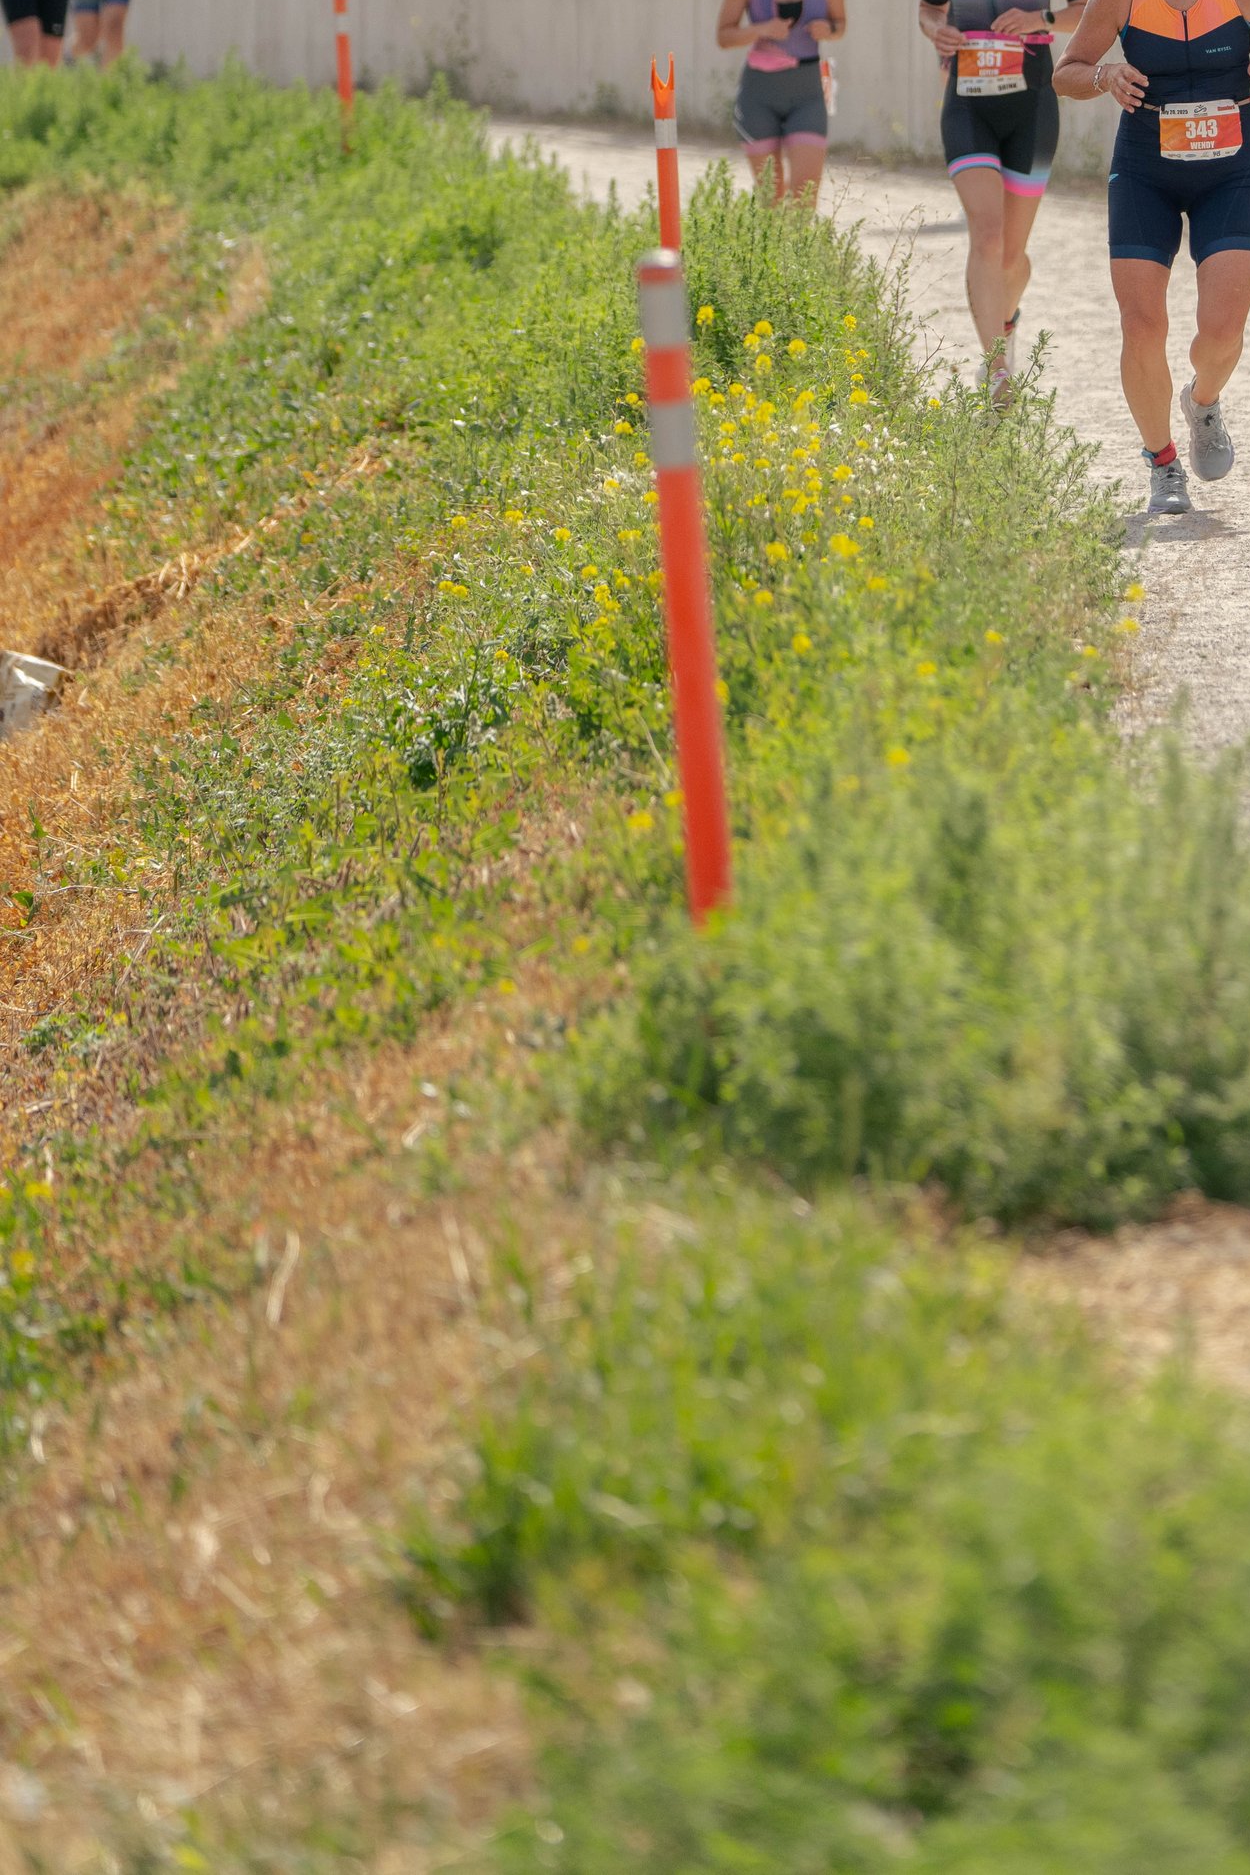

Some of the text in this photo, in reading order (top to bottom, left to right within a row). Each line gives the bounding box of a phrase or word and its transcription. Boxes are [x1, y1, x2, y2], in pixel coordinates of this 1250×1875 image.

[977, 51, 1001, 67] 361
[1185, 119, 1218, 138] 343
[1190, 140, 1215, 150] WENDY
